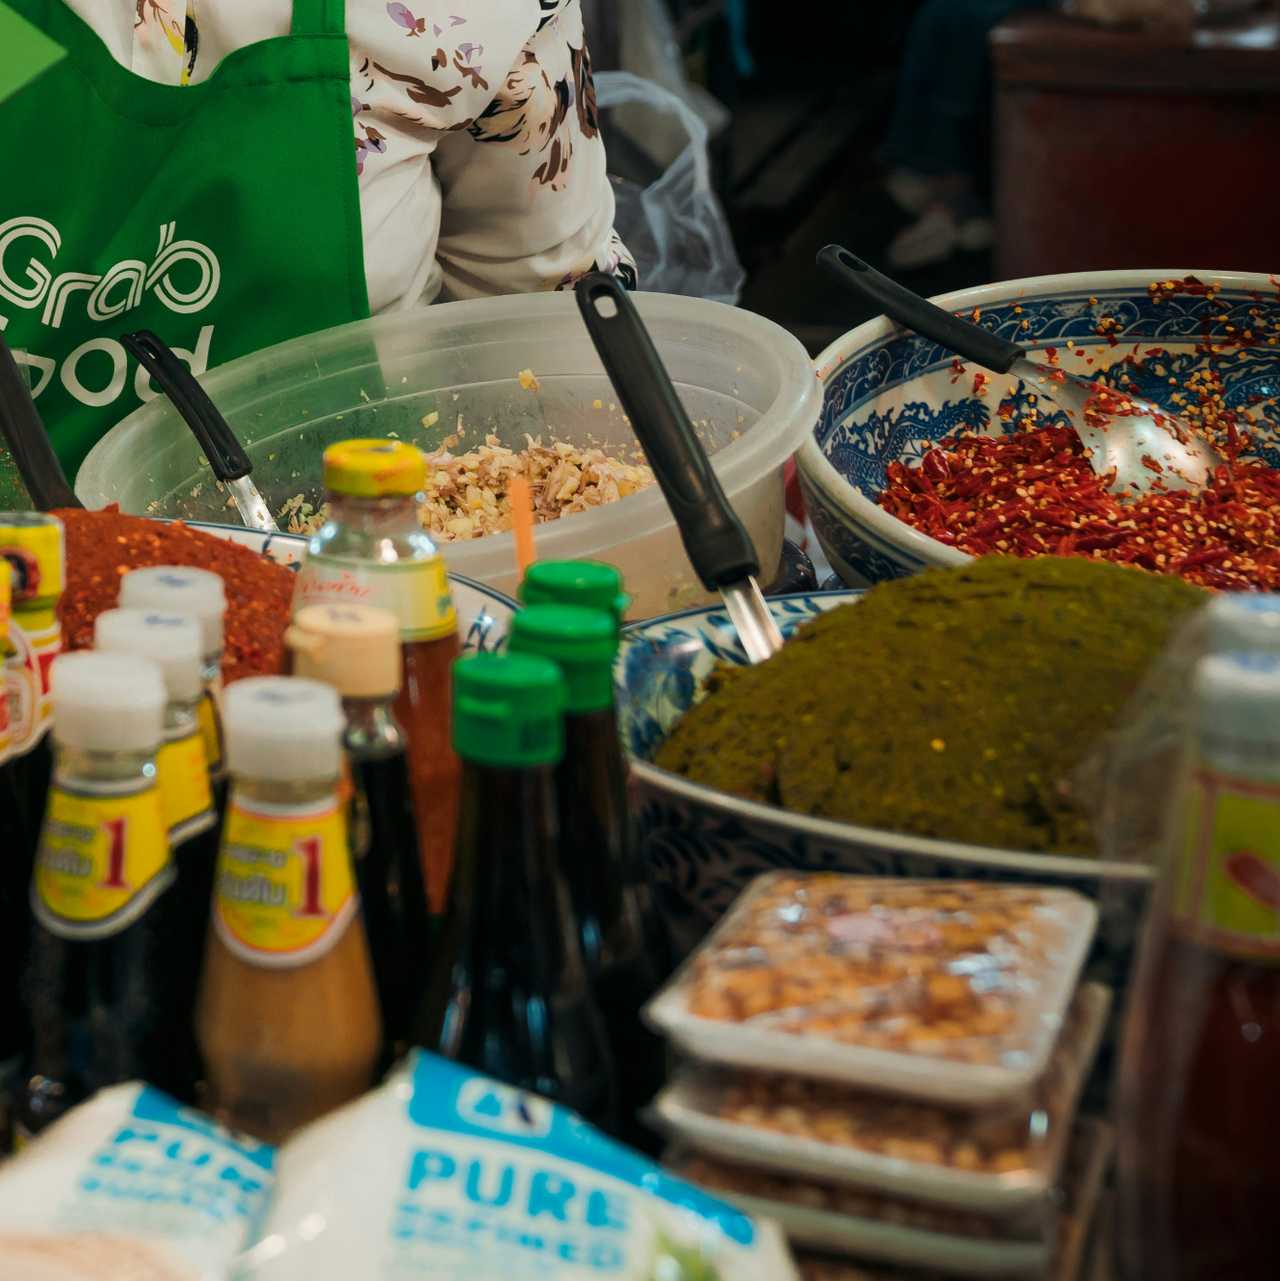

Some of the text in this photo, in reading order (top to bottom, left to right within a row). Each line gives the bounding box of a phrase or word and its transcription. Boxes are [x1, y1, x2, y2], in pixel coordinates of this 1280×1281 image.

[97, 817, 132, 891] 1
[293, 837, 328, 918] 1
[407, 1149, 628, 1232] PURE
